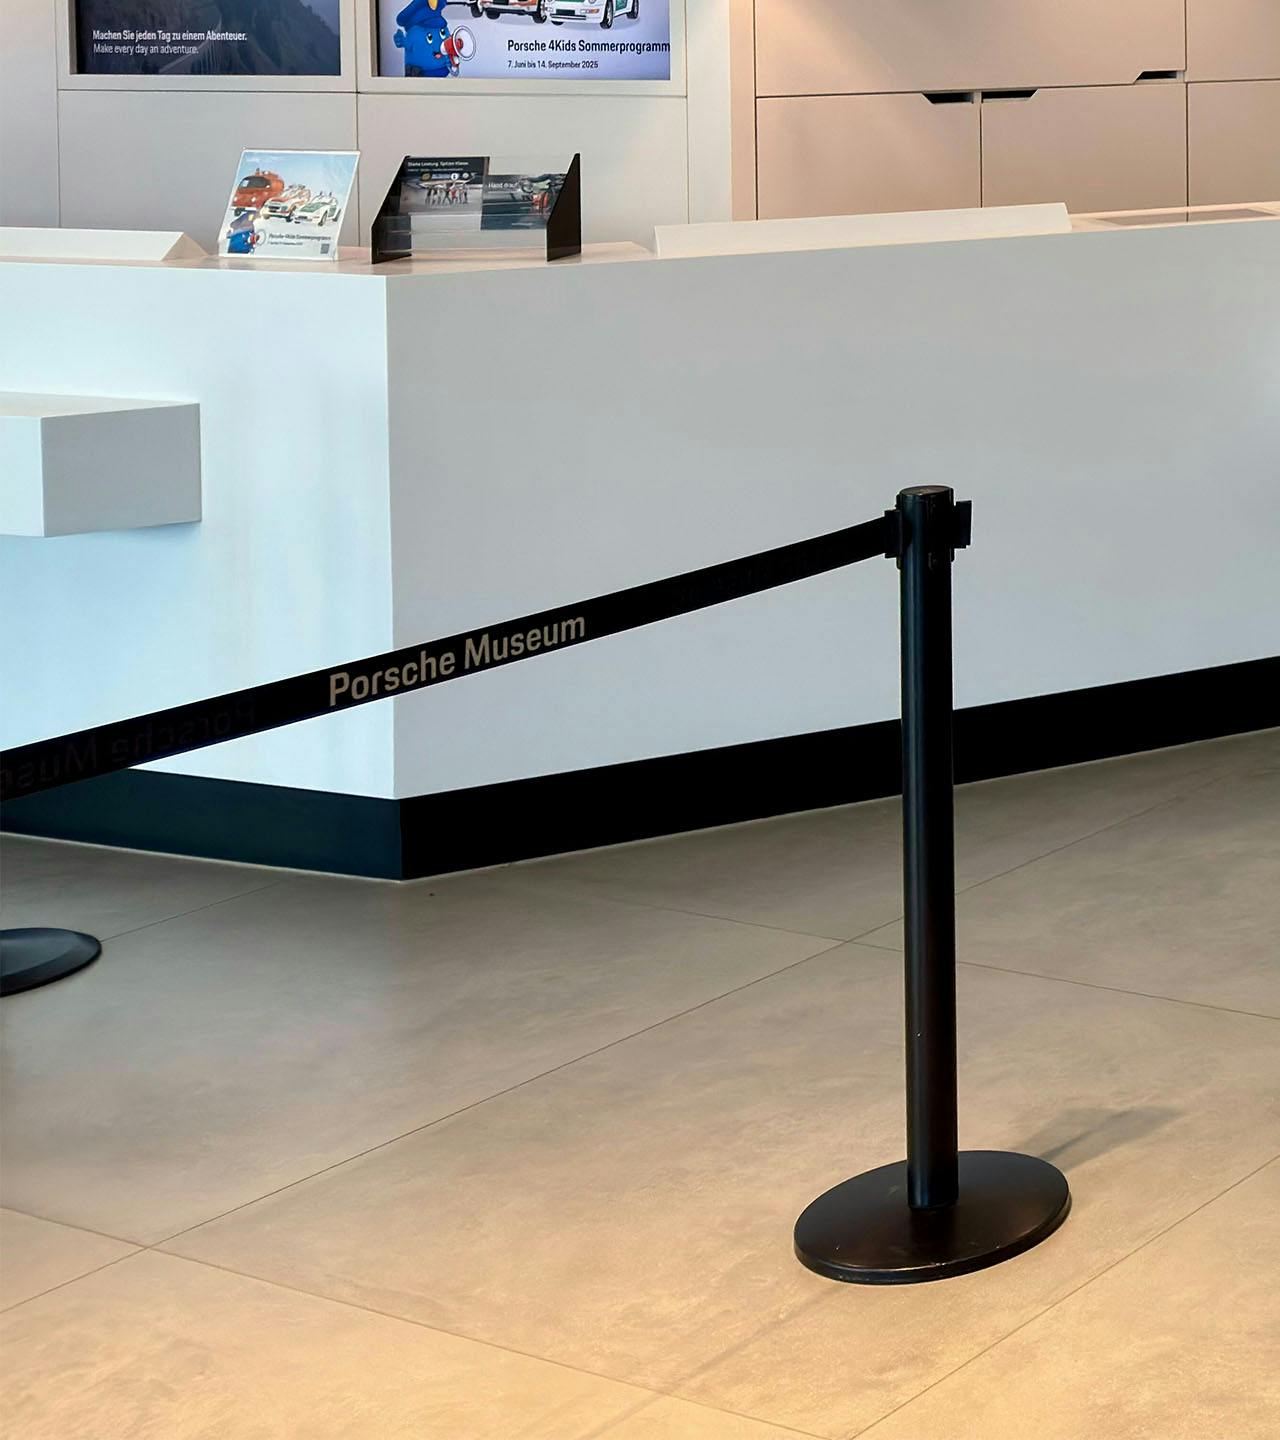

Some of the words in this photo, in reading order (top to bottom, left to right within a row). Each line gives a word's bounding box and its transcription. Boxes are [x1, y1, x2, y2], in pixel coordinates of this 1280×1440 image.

[92, 29, 122, 40] Machen
[122, 29, 135, 40] Sie
[135, 30, 157, 43] jeden
[157, 30, 171, 43] Tag
[172, 32, 181, 40] zu
[181, 30, 205, 41] einem
[206, 30, 247, 41] Abenteuer.
[93, 43, 114, 54] Make
[114, 45, 134, 56] every
[135, 43, 149, 56] day
[149, 46, 159, 54] an
[159, 44, 199, 55] adventure.
[507, 39, 546, 52] Porsche
[546, 39, 577, 52] 4Kids
[578, 39, 671, 55] Sommerprogramm
[514, 60, 527, 68] Juni
[527, 60, 536, 68] bis
[548, 60, 581, 70] September
[581, 60, 599, 69] 2025
[329, 649, 455, 707] Porsche
[464, 615, 585, 669] Museum
